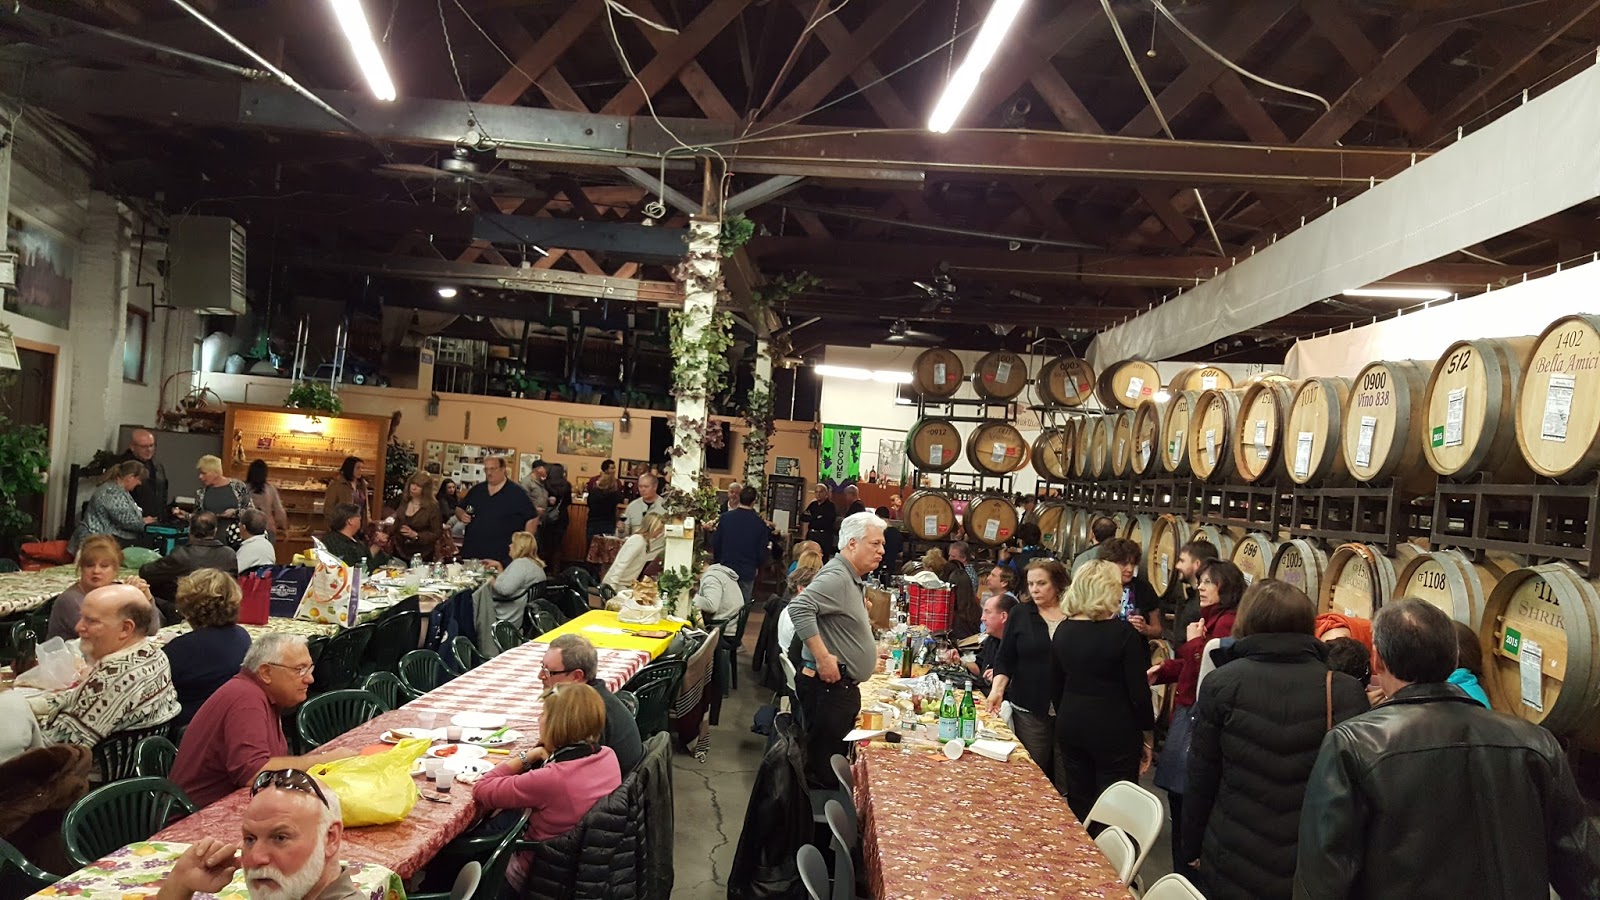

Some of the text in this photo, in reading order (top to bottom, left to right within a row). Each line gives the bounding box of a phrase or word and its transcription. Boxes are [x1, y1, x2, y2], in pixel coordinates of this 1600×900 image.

[1555, 330, 1584, 349] 1402
[1535, 351, 1599, 374] Bella Amici
[1363, 372, 1387, 391] 0900
[1301, 386, 1319, 407] 1017
[1357, 390, 1390, 408] Vino 838
[836, 430, 847, 479] WELCOME
[1505, 634, 1518, 648] 2015
